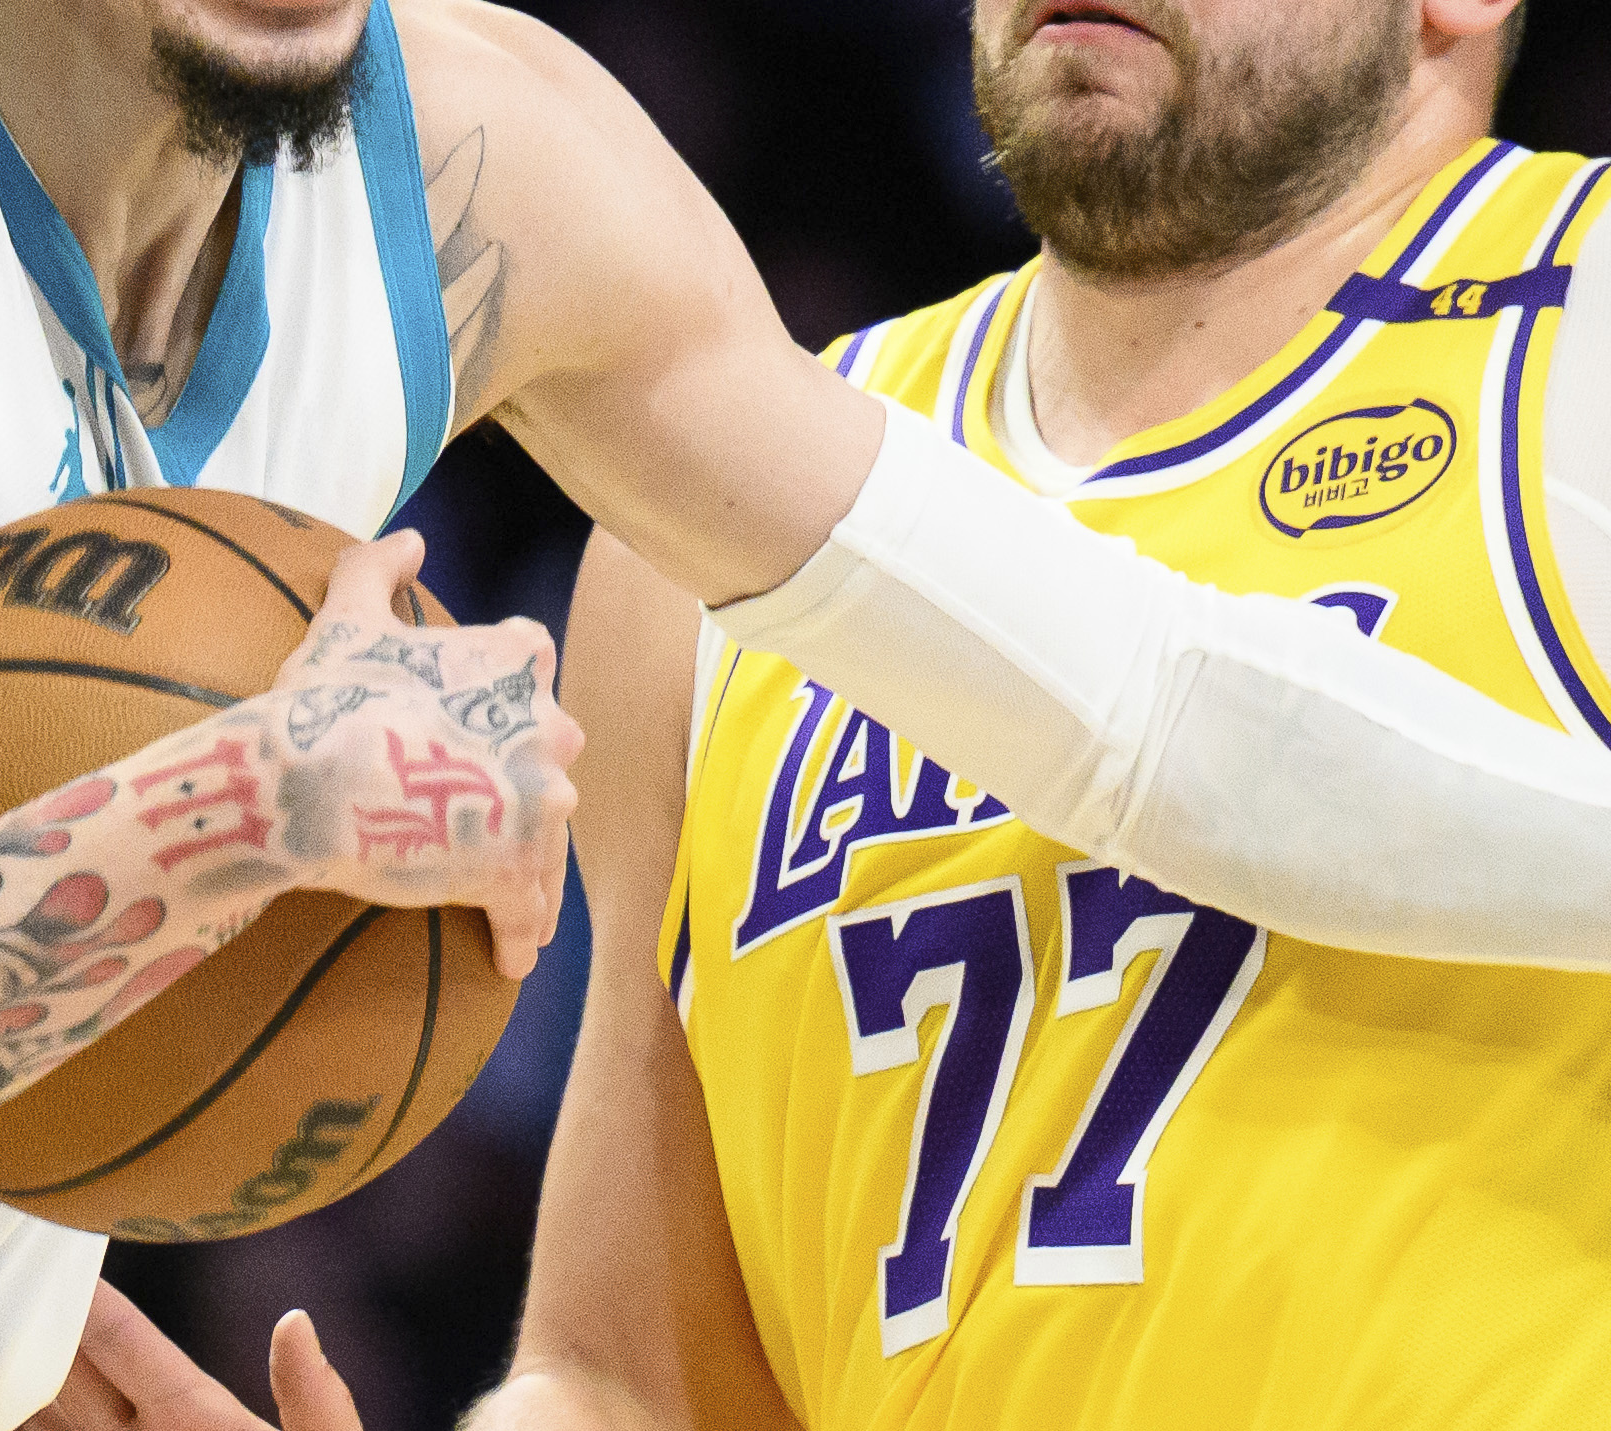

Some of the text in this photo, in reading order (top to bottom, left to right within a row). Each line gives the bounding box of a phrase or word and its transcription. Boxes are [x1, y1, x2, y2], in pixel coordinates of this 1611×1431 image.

[1430, 283, 1489, 316] 44
[1279, 433, 1444, 494] bibigo
[1303, 477, 1370, 509] 비비고
[829, 857, 1267, 1359] 77
